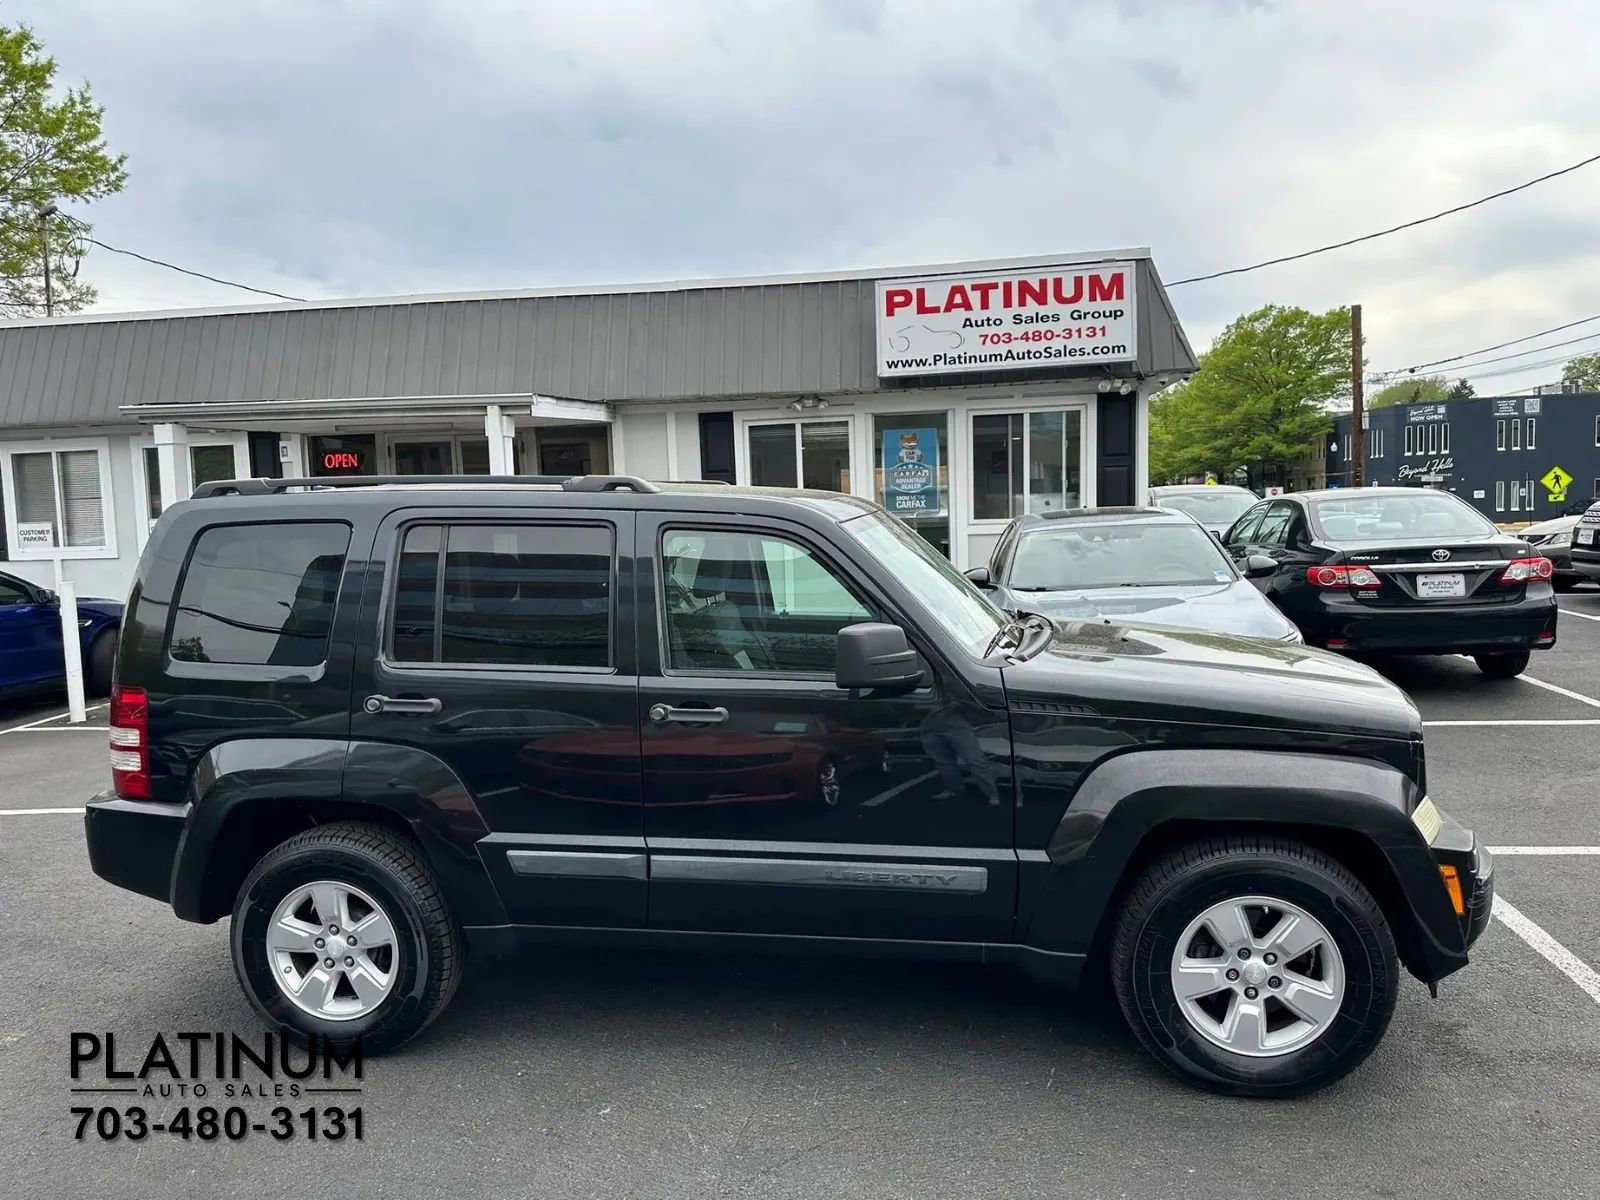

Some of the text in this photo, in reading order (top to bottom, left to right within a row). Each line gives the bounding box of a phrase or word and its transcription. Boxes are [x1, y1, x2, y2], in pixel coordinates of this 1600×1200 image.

[885, 272, 1125, 317] PLATINUM
[962, 309, 1125, 329] Auto Sales Group
[979, 325, 1107, 346] 703-480-3131
[886, 343, 1127, 369] www.PlatinumAutoSales.com
[324, 453, 358, 469] OPEN
[1398, 457, 1454, 479] Beyond Hello
[896, 500, 926, 509] CARFAX
[824, 868, 958, 886] LIBERTY
